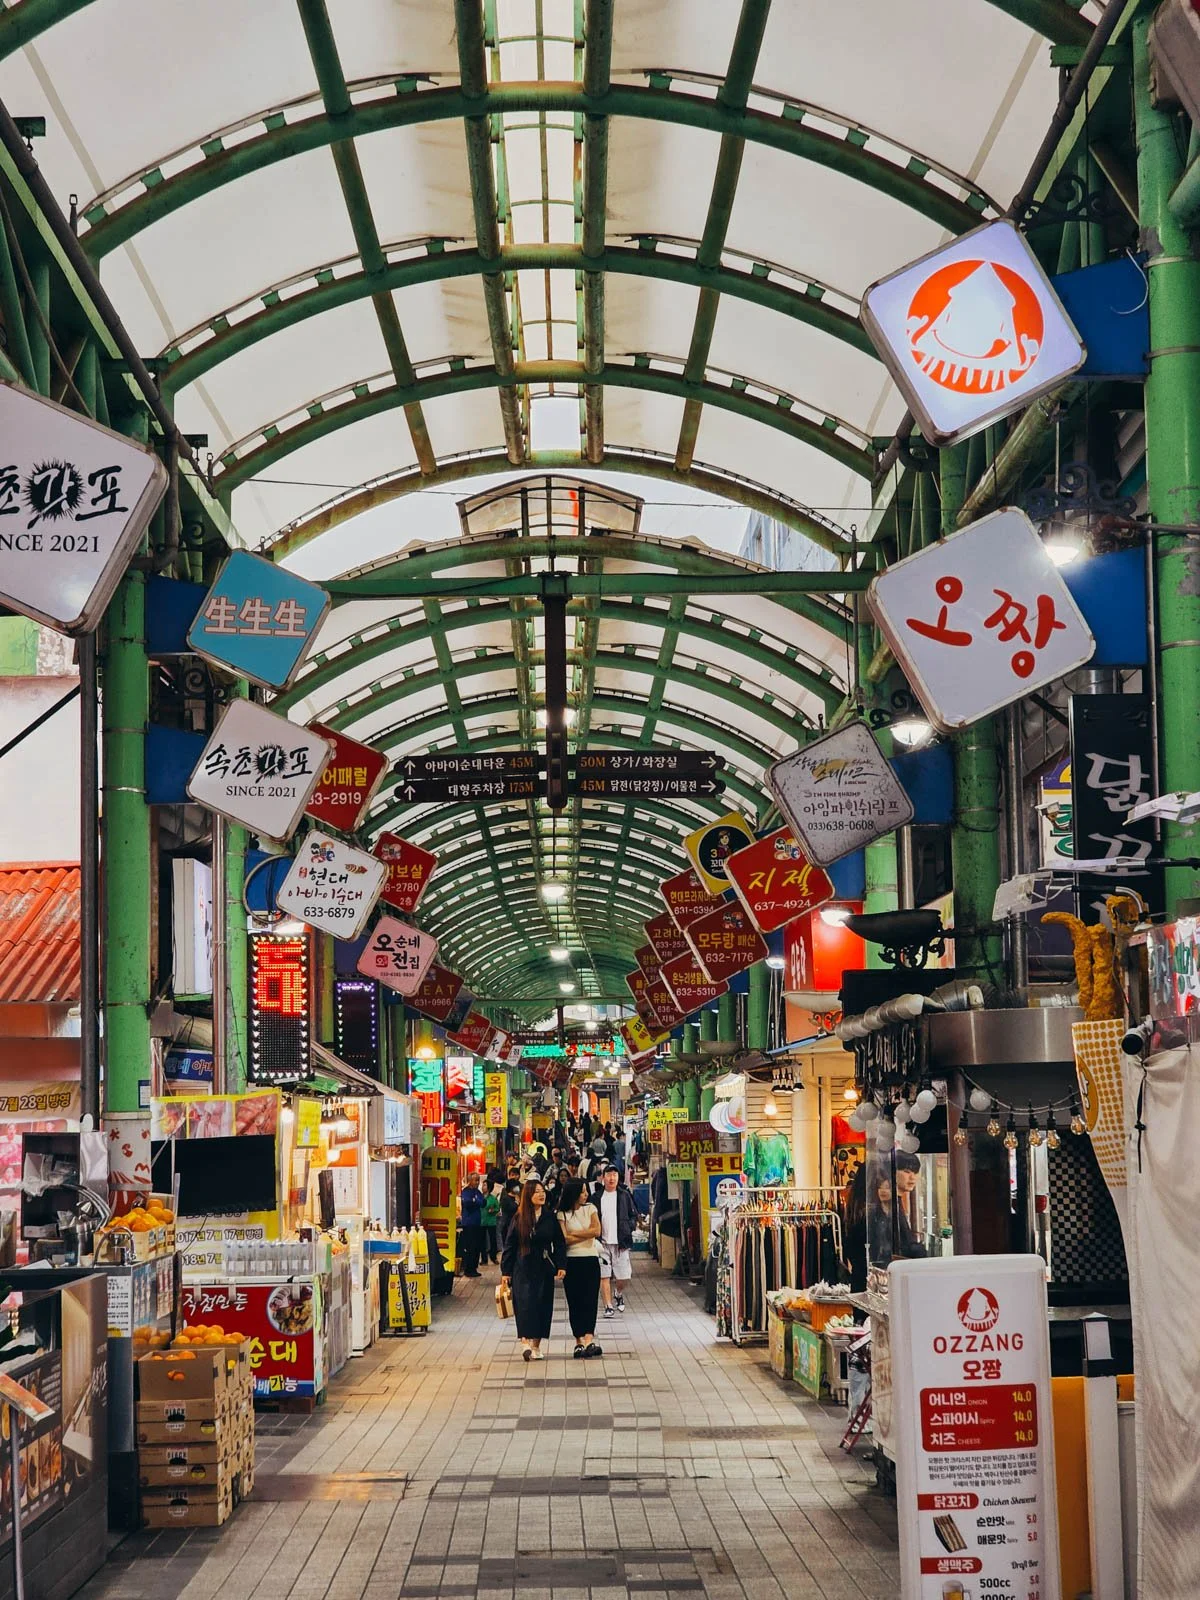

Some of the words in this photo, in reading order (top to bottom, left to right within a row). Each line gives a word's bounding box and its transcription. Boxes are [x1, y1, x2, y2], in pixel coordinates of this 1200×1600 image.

[0, 533, 43, 552] NCE
[50, 534, 100, 553] 2021
[204, 595, 308, 638] 生生生
[905, 575, 1067, 680] 오짱
[424, 757, 506, 773] 아바이순대타운
[509, 756, 534, 768] 45M
[580, 756, 606, 768] 50M
[609, 756, 678, 768] 상가/화장실
[317, 766, 368, 787] 어패럴
[226, 785, 265, 797] SINCE
[268, 786, 297, 798] 2021
[448, 782, 506, 797] 대형주차장
[508, 781, 534, 793] 175M
[580, 779, 606, 792] 45M
[803, 799, 900, 817] 아임파인쉬림프
[808, 820, 875, 832] 033)638-0608
[309, 867, 349, 886] 현대
[288, 886, 363, 906] 아바이순대
[303, 906, 356, 919] 633-6879
[754, 899, 812, 912] 637-4924
[372, 933, 421, 952] 오순네
[698, 932, 736, 950] 모두랑
[391, 950, 420, 970] 전집
[705, 952, 754, 963] 632-7176
[417, 984, 456, 996] EAT
[675, 987, 717, 997] 632-5310
[19, 1095, 48, 1111] 28일
[48, 1092, 71, 1109] 방영
[176, 1229, 206, 1243] 017년
[245, 1227, 264, 1240] 방영
[932, 1332, 1024, 1354] OZZANG
[962, 1358, 1002, 1381] 오짱
[928, 1391, 967, 1407] 어니언
[1012, 1389, 1032, 1403] 14.0
[929, 1411, 979, 1426] 스파이시
[1012, 1409, 1033, 1423] 14.0
[930, 1432, 956, 1446] 치즈
[1014, 1429, 1034, 1443] 14.0
[934, 1494, 971, 1509] 닭꼬치
[982, 1496, 1010, 1507] Chicken
[976, 1516, 1005, 1528] 순한맛
[1026, 1513, 1037, 1524] 5.0
[977, 1534, 1006, 1545] 매운맛
[1027, 1531, 1038, 1542] 5.0
[937, 1559, 974, 1572] 생맥주
[979, 1577, 1011, 1589] 500cc
